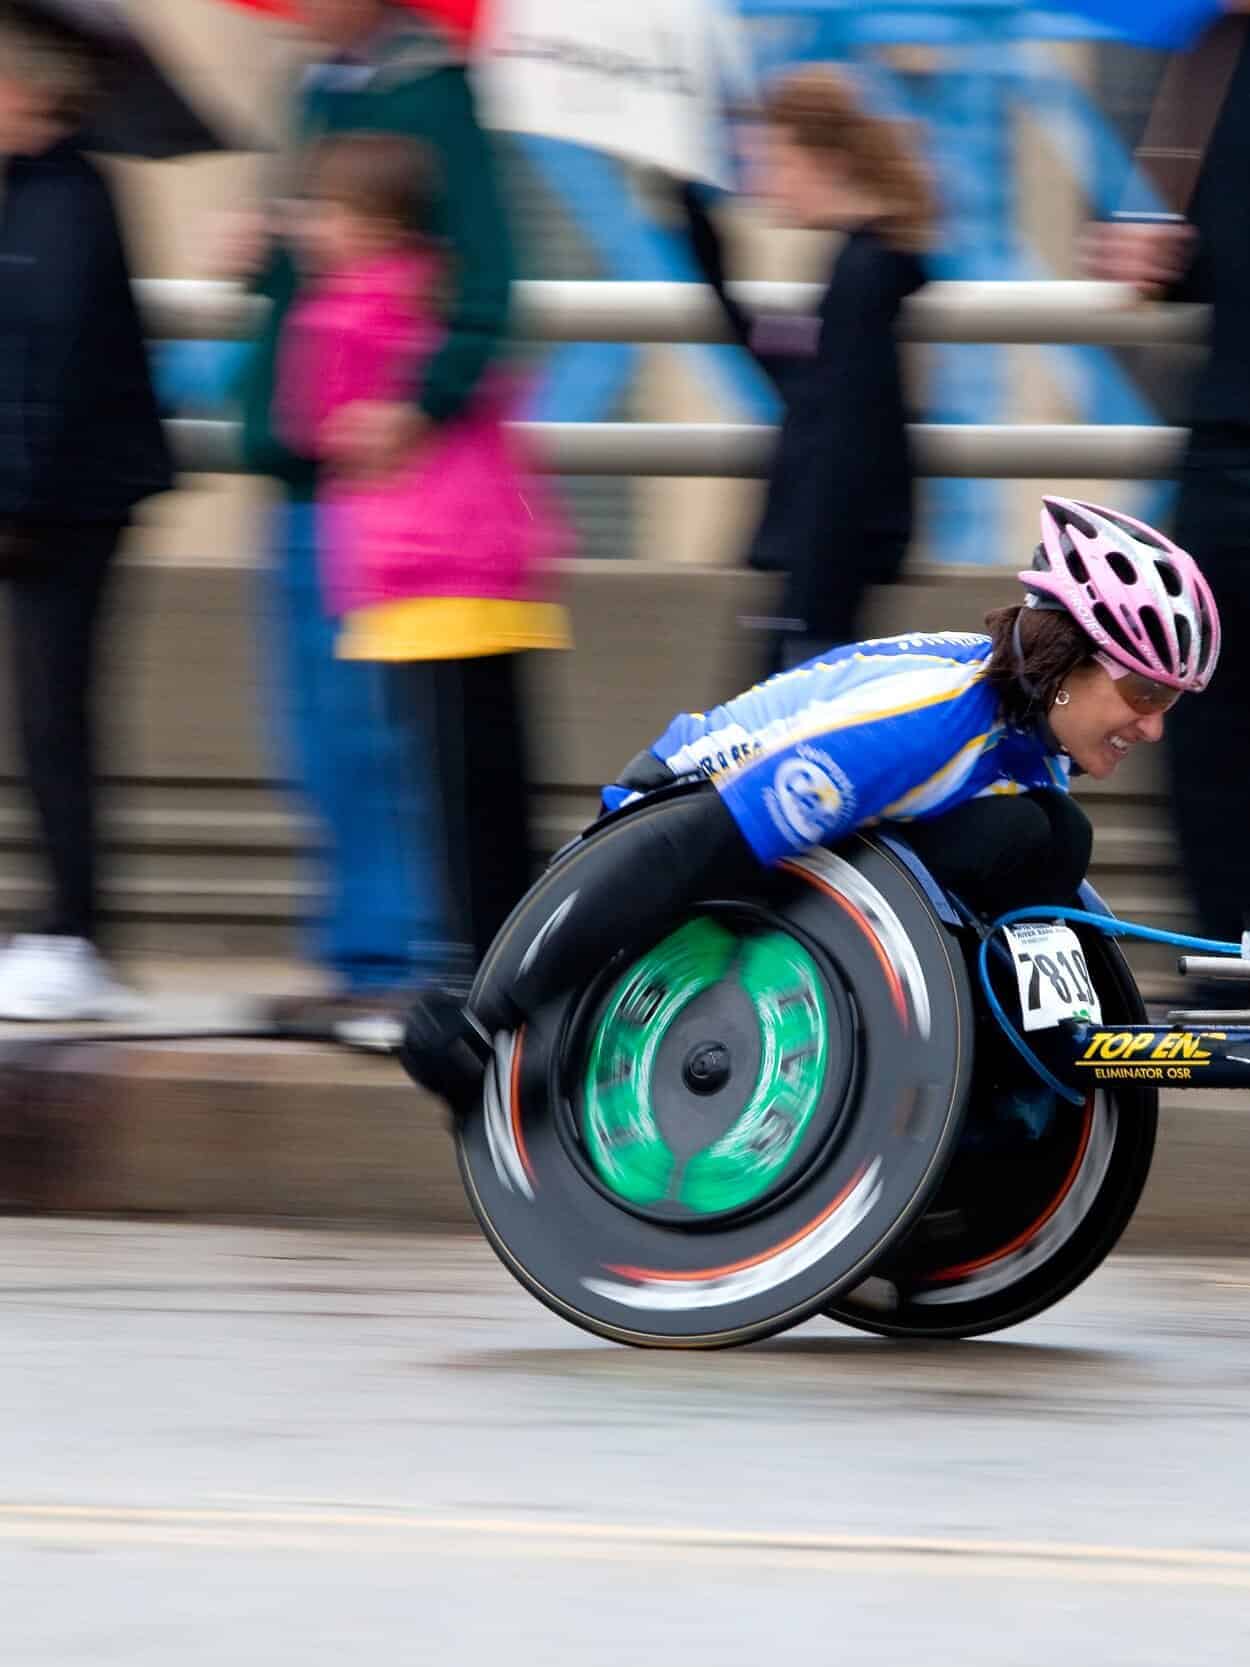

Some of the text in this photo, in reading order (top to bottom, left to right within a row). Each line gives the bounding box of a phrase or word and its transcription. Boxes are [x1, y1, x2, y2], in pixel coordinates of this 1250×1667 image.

[1018, 950, 1095, 1011] 7819
[1083, 1032, 1155, 1059] TOP
[1095, 1067, 1192, 1079] ELIMINATOR OSR
